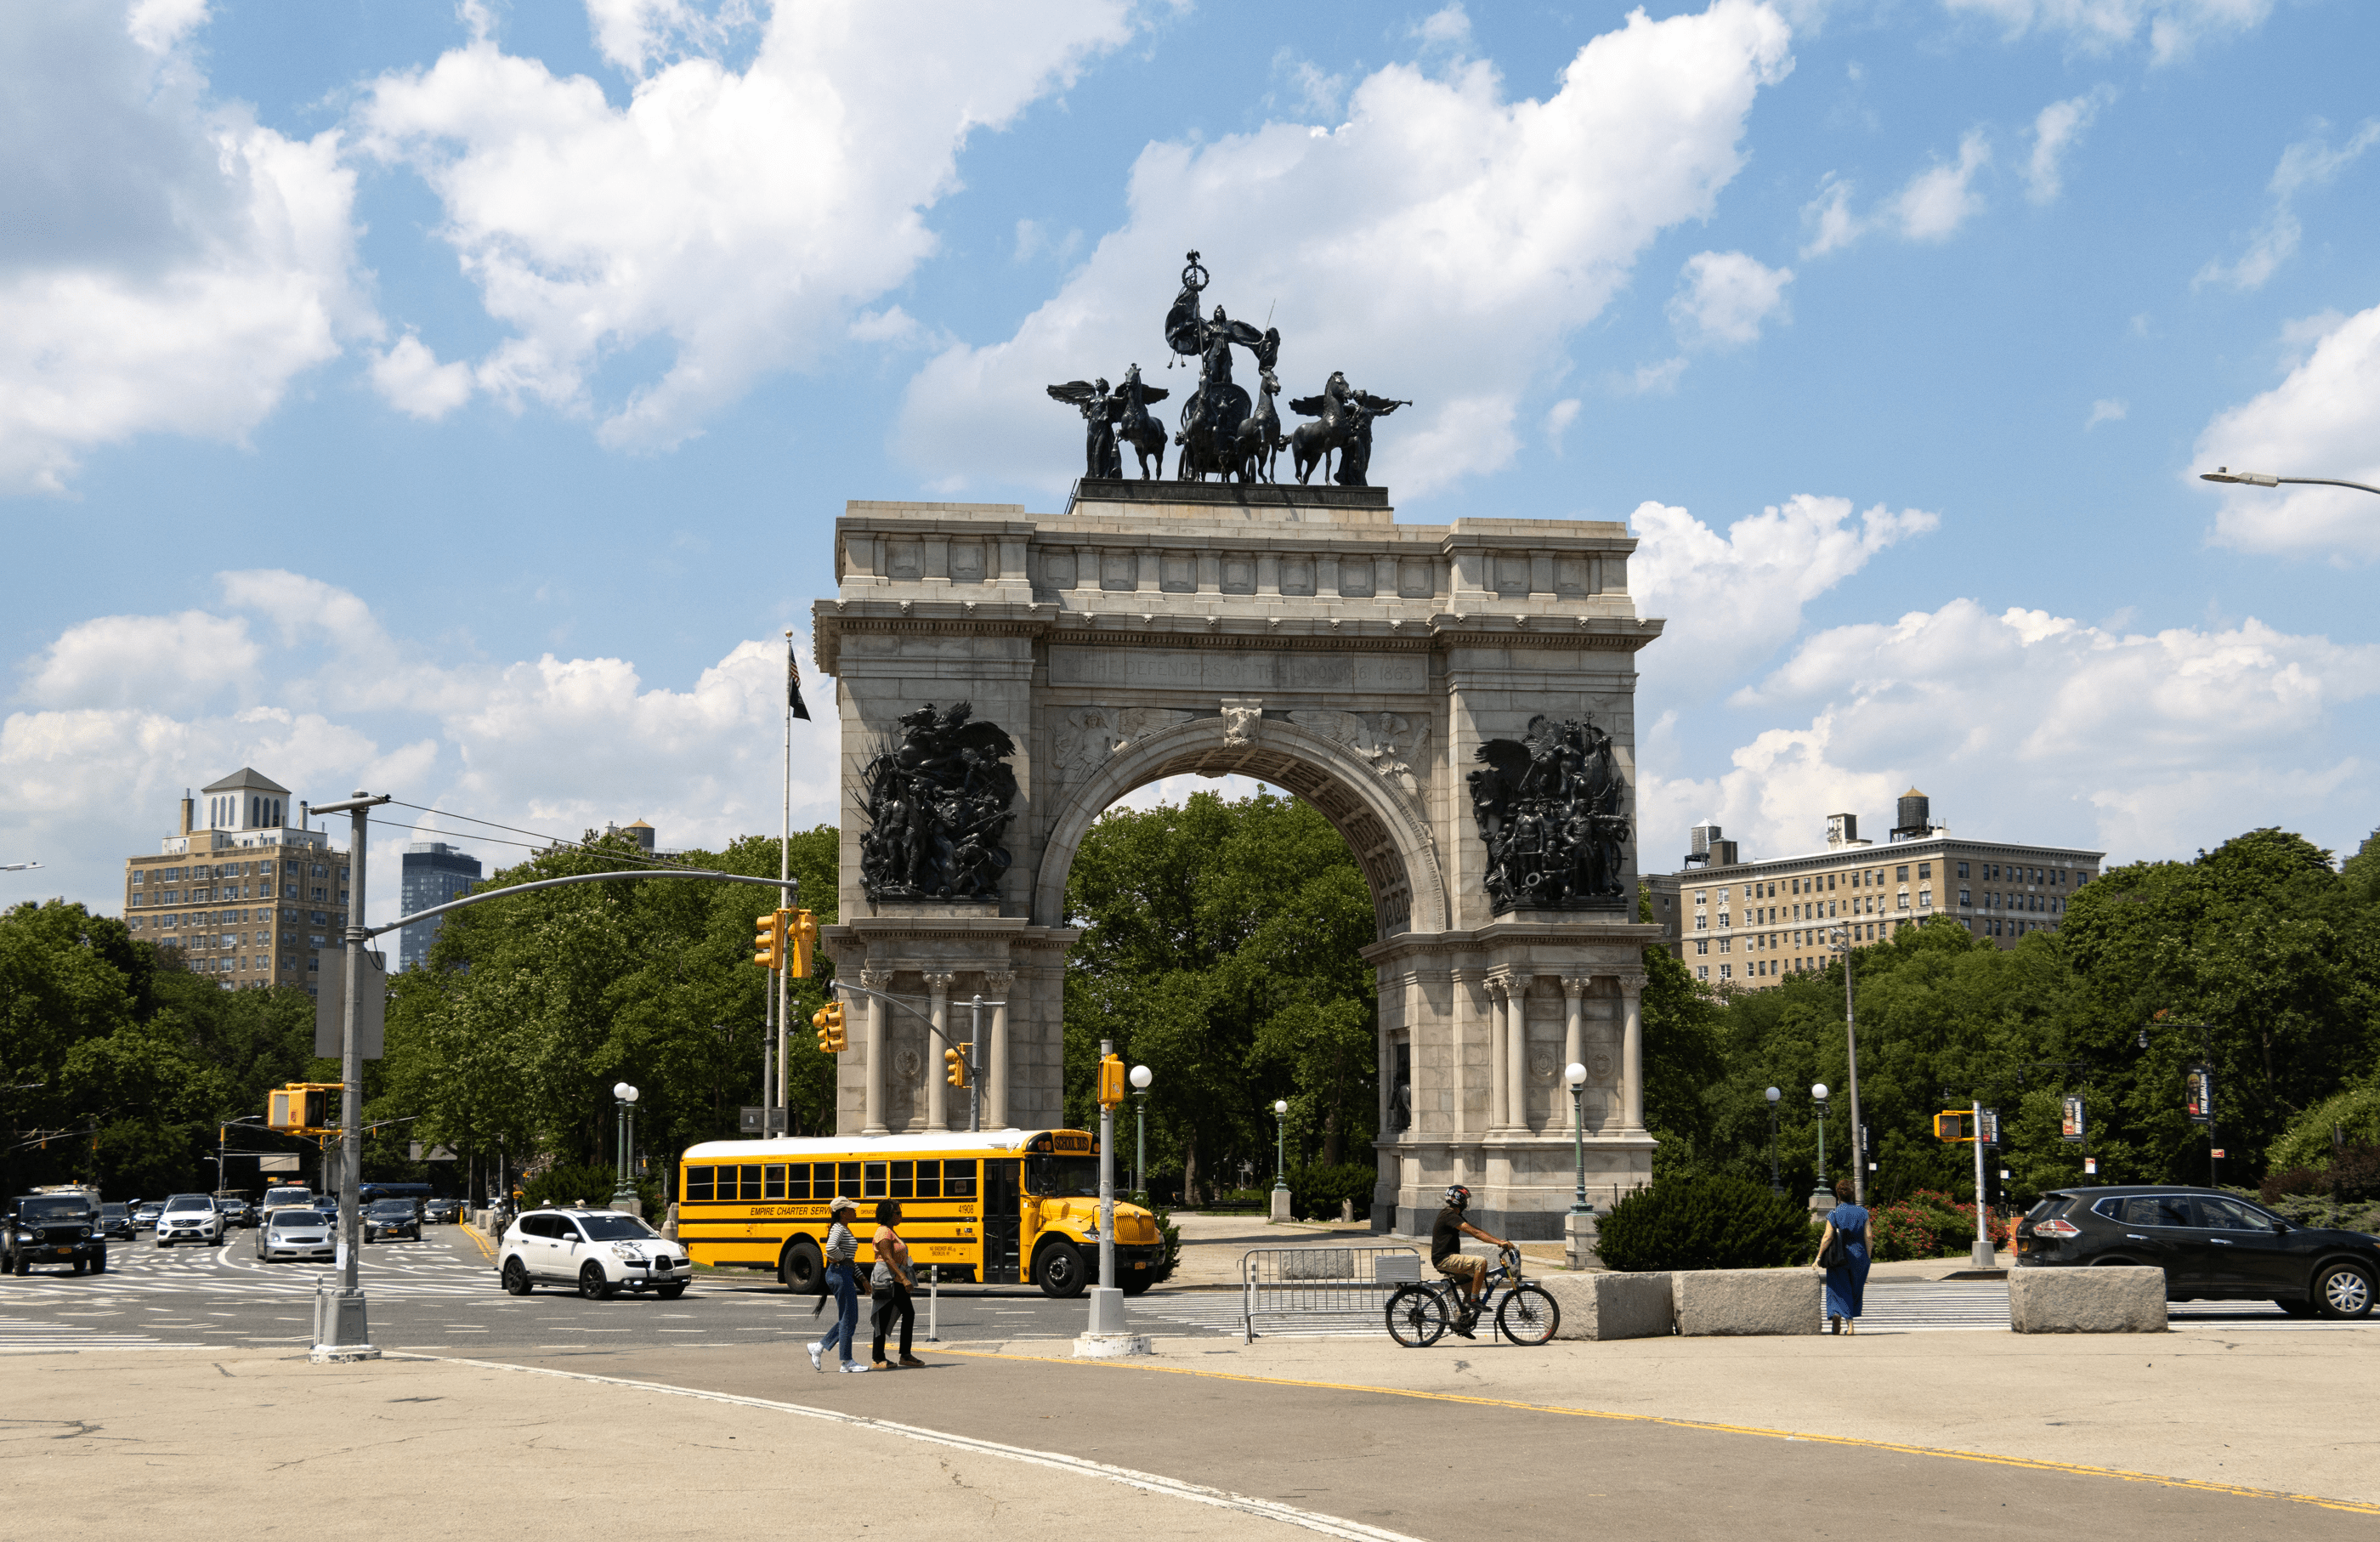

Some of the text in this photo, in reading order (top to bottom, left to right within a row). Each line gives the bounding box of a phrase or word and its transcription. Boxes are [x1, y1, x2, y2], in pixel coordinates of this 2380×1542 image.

[1062, 659, 1082, 673] TO
[1088, 660, 1119, 674] THE
[1125, 660, 1221, 677] DEFENDERS
[1231, 663, 1250, 677] OF
[1256, 664, 1288, 678] THE
[1292, 665, 1339, 679] UNION
[1380, 666, 1413, 680] 1865
[751, 1207, 774, 1216] EMPIRE
[777, 1207, 808, 1216] CHARTER
[958, 1205, 974, 1214] 41908
